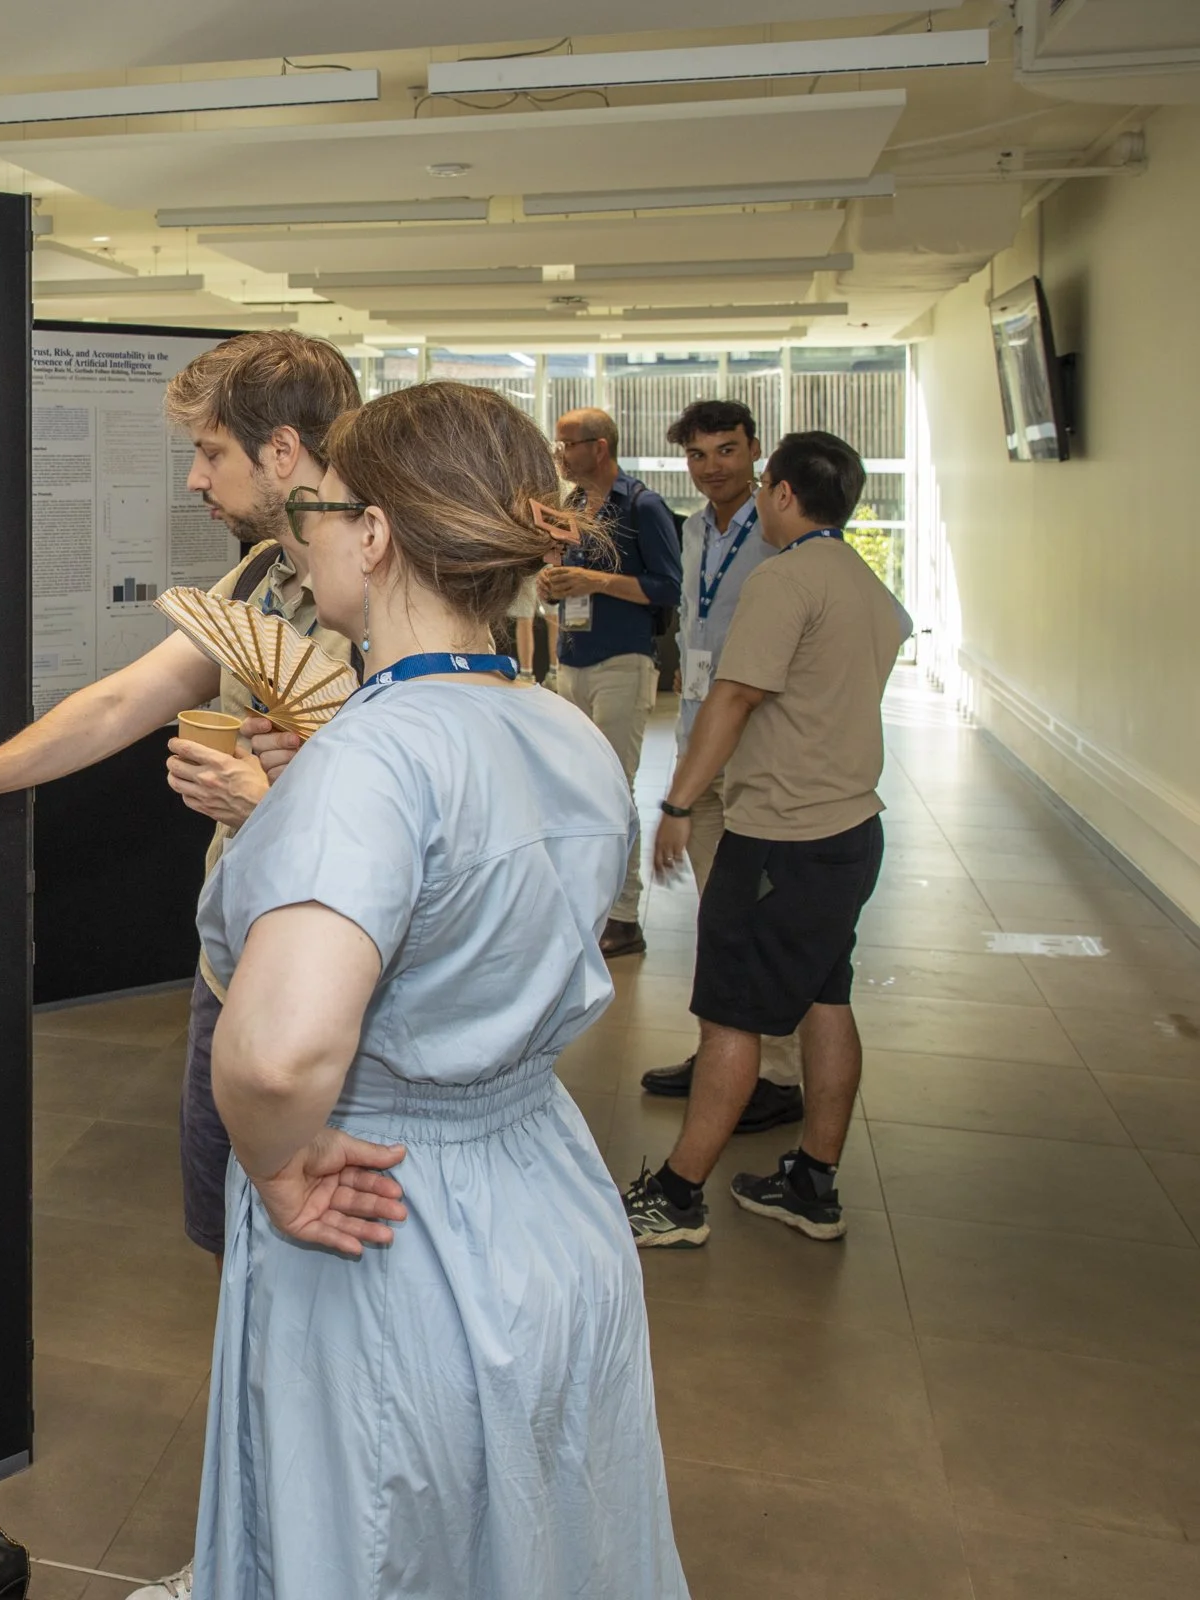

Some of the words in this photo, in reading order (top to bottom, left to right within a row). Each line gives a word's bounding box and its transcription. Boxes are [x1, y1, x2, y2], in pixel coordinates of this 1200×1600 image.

[32, 347, 52, 357] rust,
[54, 347, 74, 358] Risk,
[75, 349, 89, 358] and
[92, 350, 145, 361] Accountability
[147, 351, 155, 360] in
[157, 352, 168, 361] the
[31, 358, 62, 366] resence
[64, 358, 73, 366] of
[75, 359, 107, 368] Artificial
[110, 361, 152, 371] Intelligence
